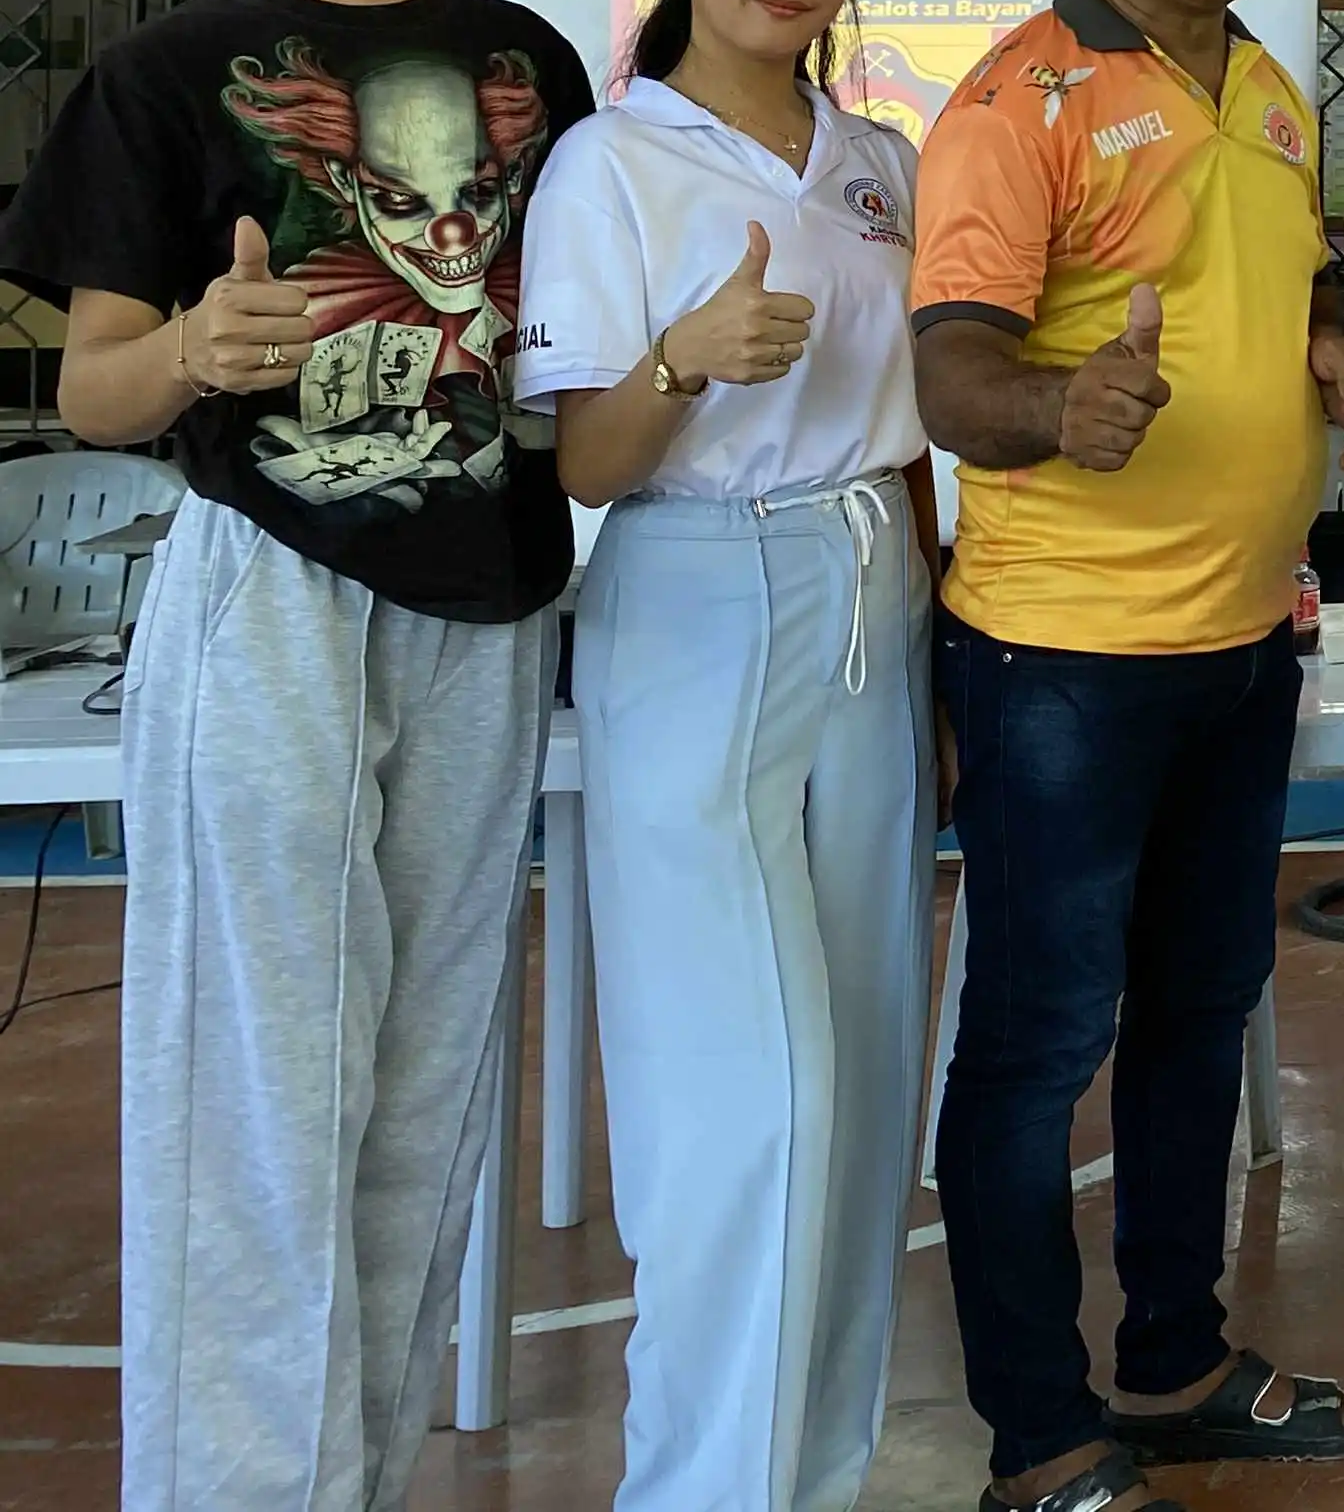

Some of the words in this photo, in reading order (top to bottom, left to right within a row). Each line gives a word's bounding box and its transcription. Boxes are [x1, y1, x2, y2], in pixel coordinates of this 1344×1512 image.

[858, 0, 919, 17] Salot
[923, 3, 950, 17] sa
[1091, 110, 1174, 160] MANUEL
